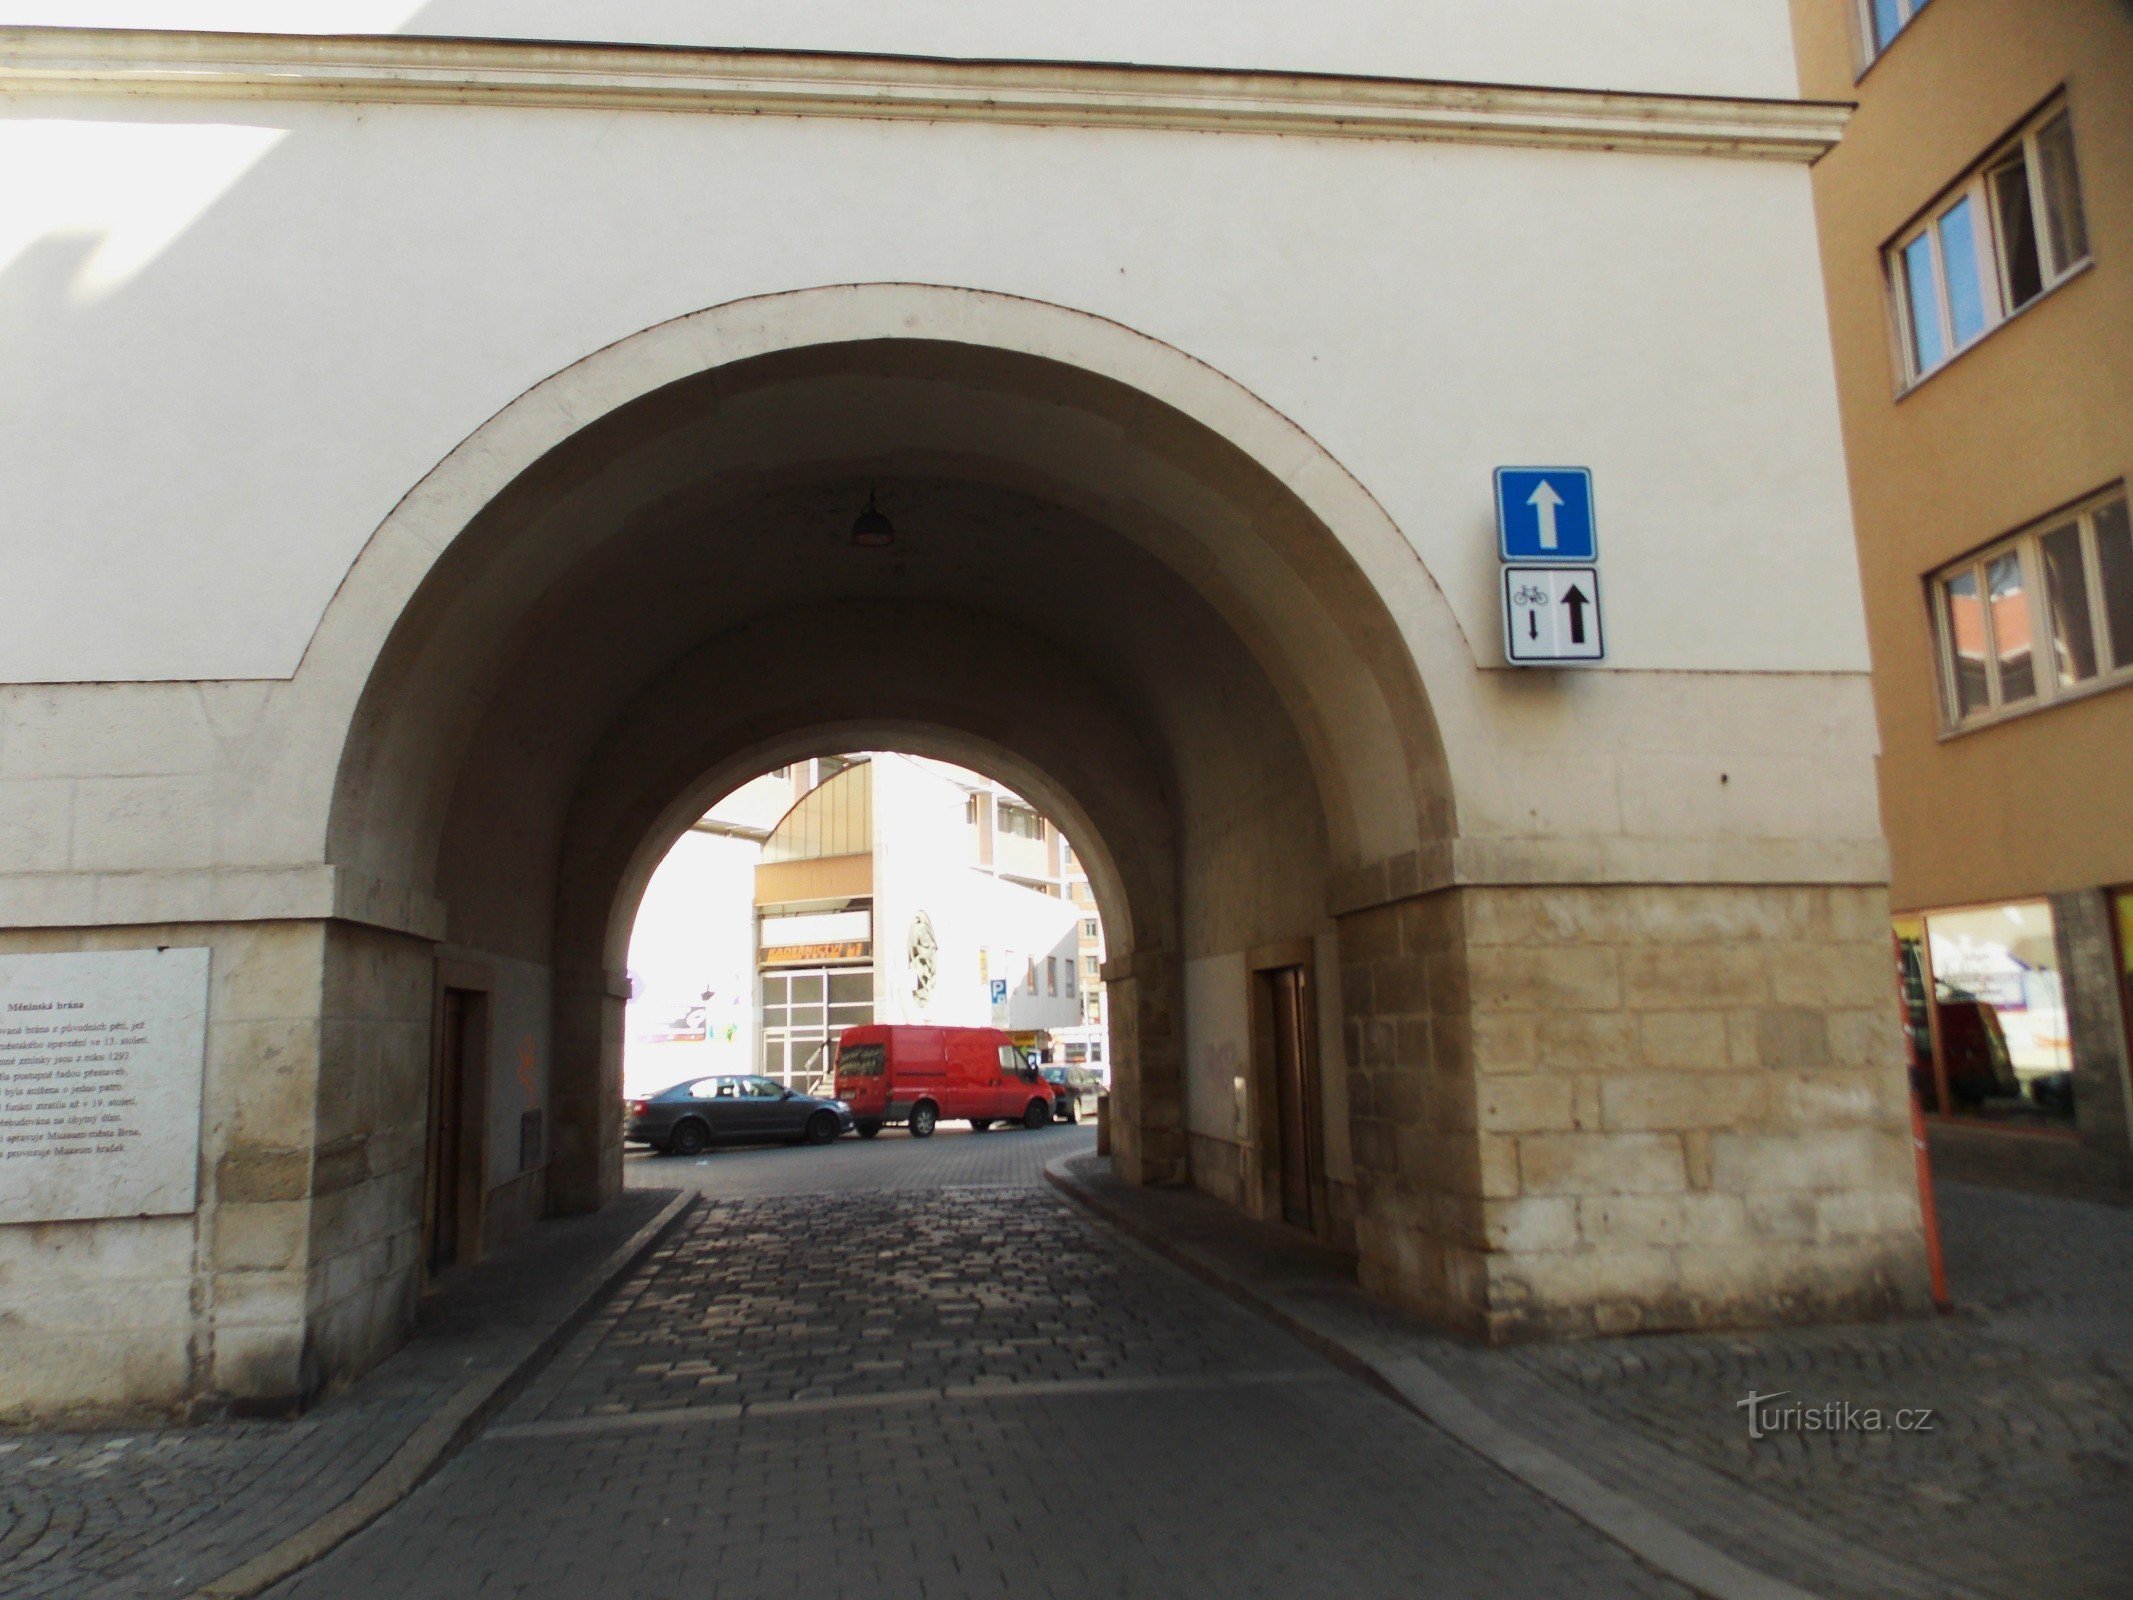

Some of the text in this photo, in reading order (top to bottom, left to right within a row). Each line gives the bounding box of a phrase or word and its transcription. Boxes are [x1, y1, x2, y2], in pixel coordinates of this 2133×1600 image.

[992, 981, 1005, 999] P
[56, 1001, 84, 1010] brána
[47, 1131, 87, 1141] Muzeum
[54, 1146, 93, 1156] Muzeum
